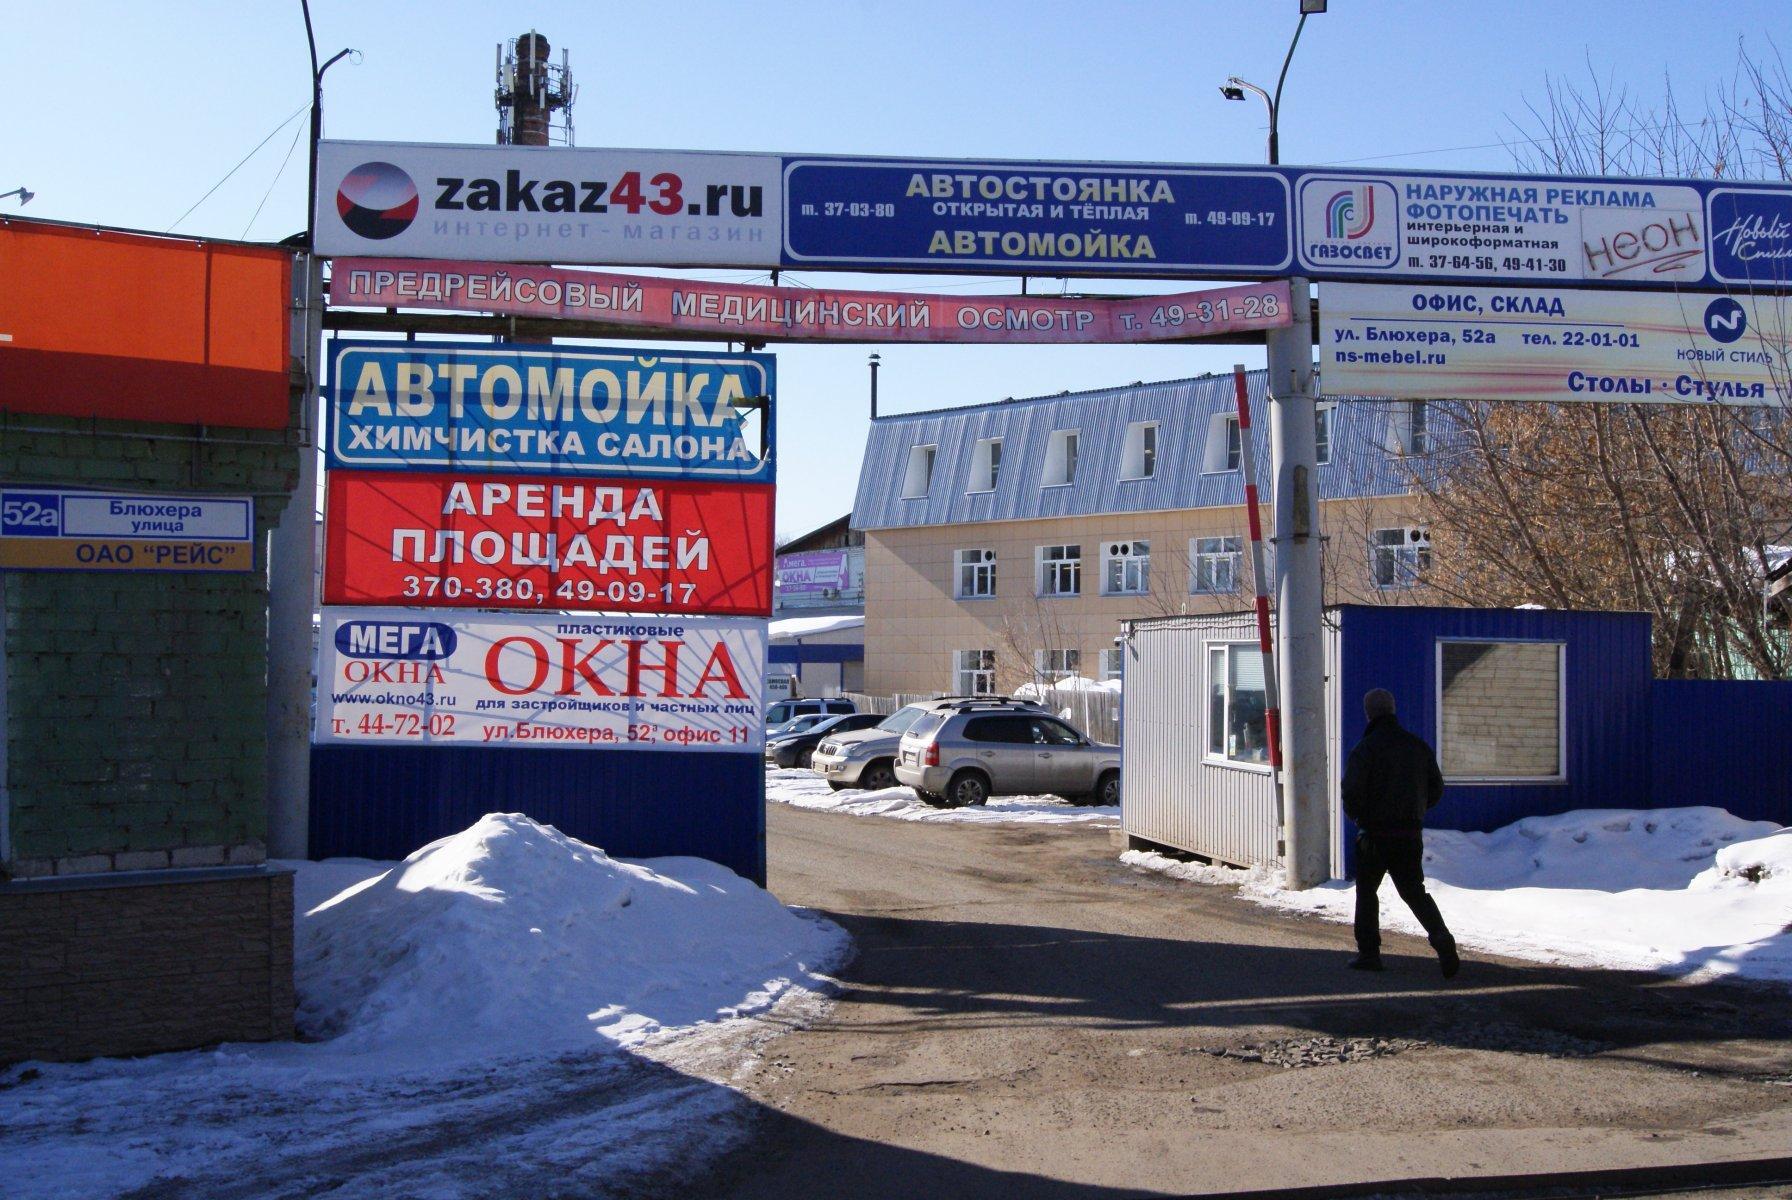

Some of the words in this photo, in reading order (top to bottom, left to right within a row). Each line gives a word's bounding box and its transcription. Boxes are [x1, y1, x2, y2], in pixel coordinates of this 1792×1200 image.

[435, 169, 763, 217] zakaz43.ru
[906, 173, 1175, 203] АВТОСТОЯНКА
[1406, 184, 1538, 203] НАРУЖНАЯ
[1546, 188, 1656, 208] РЕКЛАМА
[825, 202, 895, 218] 37-03-80
[933, 201, 1044, 219] ОТКРЫТАЯ
[1050, 205, 1063, 218] И
[1069, 202, 1149, 221] ТЁПЛАЯ
[1207, 211, 1275, 227] 49-09-17
[1406, 203, 1569, 224] ФОТОПЕЧАТЬ
[1407, 222, 1509, 234] интерьерная
[1514, 225, 1523, 233] и
[928, 228, 1156, 259] АВТОМОЙКА
[1310, 244, 1392, 260] ГАЗОСВЕТ
[1407, 236, 1559, 250] широкоформатная
[1430, 255, 1497, 272] 37-64-56,
[1503, 257, 1566, 272] 49-41-30
[350, 270, 643, 312] ПРЕДРЕЙСОВЫЙ
[672, 291, 931, 329] МЕДИЦИНСКИЙ
[957, 306, 1094, 332] ОСМОТР
[1120, 314, 1142, 330] т.
[1151, 293, 1280, 327] 49-31-28
[1412, 293, 1485, 315] ОФИС,
[1491, 295, 1565, 318] СКЛАД
[1335, 329, 1360, 344] ул.
[1366, 325, 1455, 347] Блюхера,
[1462, 328, 1496, 345] 52а
[1522, 332, 1557, 348] тел.
[1562, 330, 1640, 349] 22-01-01
[1335, 349, 1446, 366] ns-mebel.ru
[1677, 348, 1725, 362] НОВЫЙ
[1730, 351, 1773, 364] СТИЛЬ
[348, 356, 749, 428] АВТОМОЙКА
[1567, 371, 1652, 395] Столы
[1675, 374, 1765, 401] Стулья
[348, 424, 586, 455] ХИМЧИСТКА
[597, 430, 752, 462] САЛОНА
[3, 501, 58, 527] 52а
[110, 500, 202, 518] Блюхера
[442, 480, 664, 527] АРЕНДА
[132, 520, 184, 533] улица
[76, 544, 133, 563] ОАО
[391, 528, 709, 576] ПЛОЩАДЕЙ
[402, 575, 544, 605] 370-380,
[556, 580, 697, 604] 49-09-17
[349, 622, 444, 655] МЕГА
[557, 623, 684, 637] пластиковые
[343, 660, 446, 684] ОКНА
[484, 635, 751, 699] ОКНА
[331, 691, 456, 707] www.okno43.ru
[475, 699, 507, 711] для
[511, 698, 630, 713] застройщиков
[635, 702, 644, 711] и
[650, 702, 719, 714] частных
[724, 704, 755, 716] лиц
[331, 719, 351, 735] т.
[357, 713, 456, 737] 44-72-02
[663, 726, 721, 746] офис
[728, 726, 749, 743] 11
